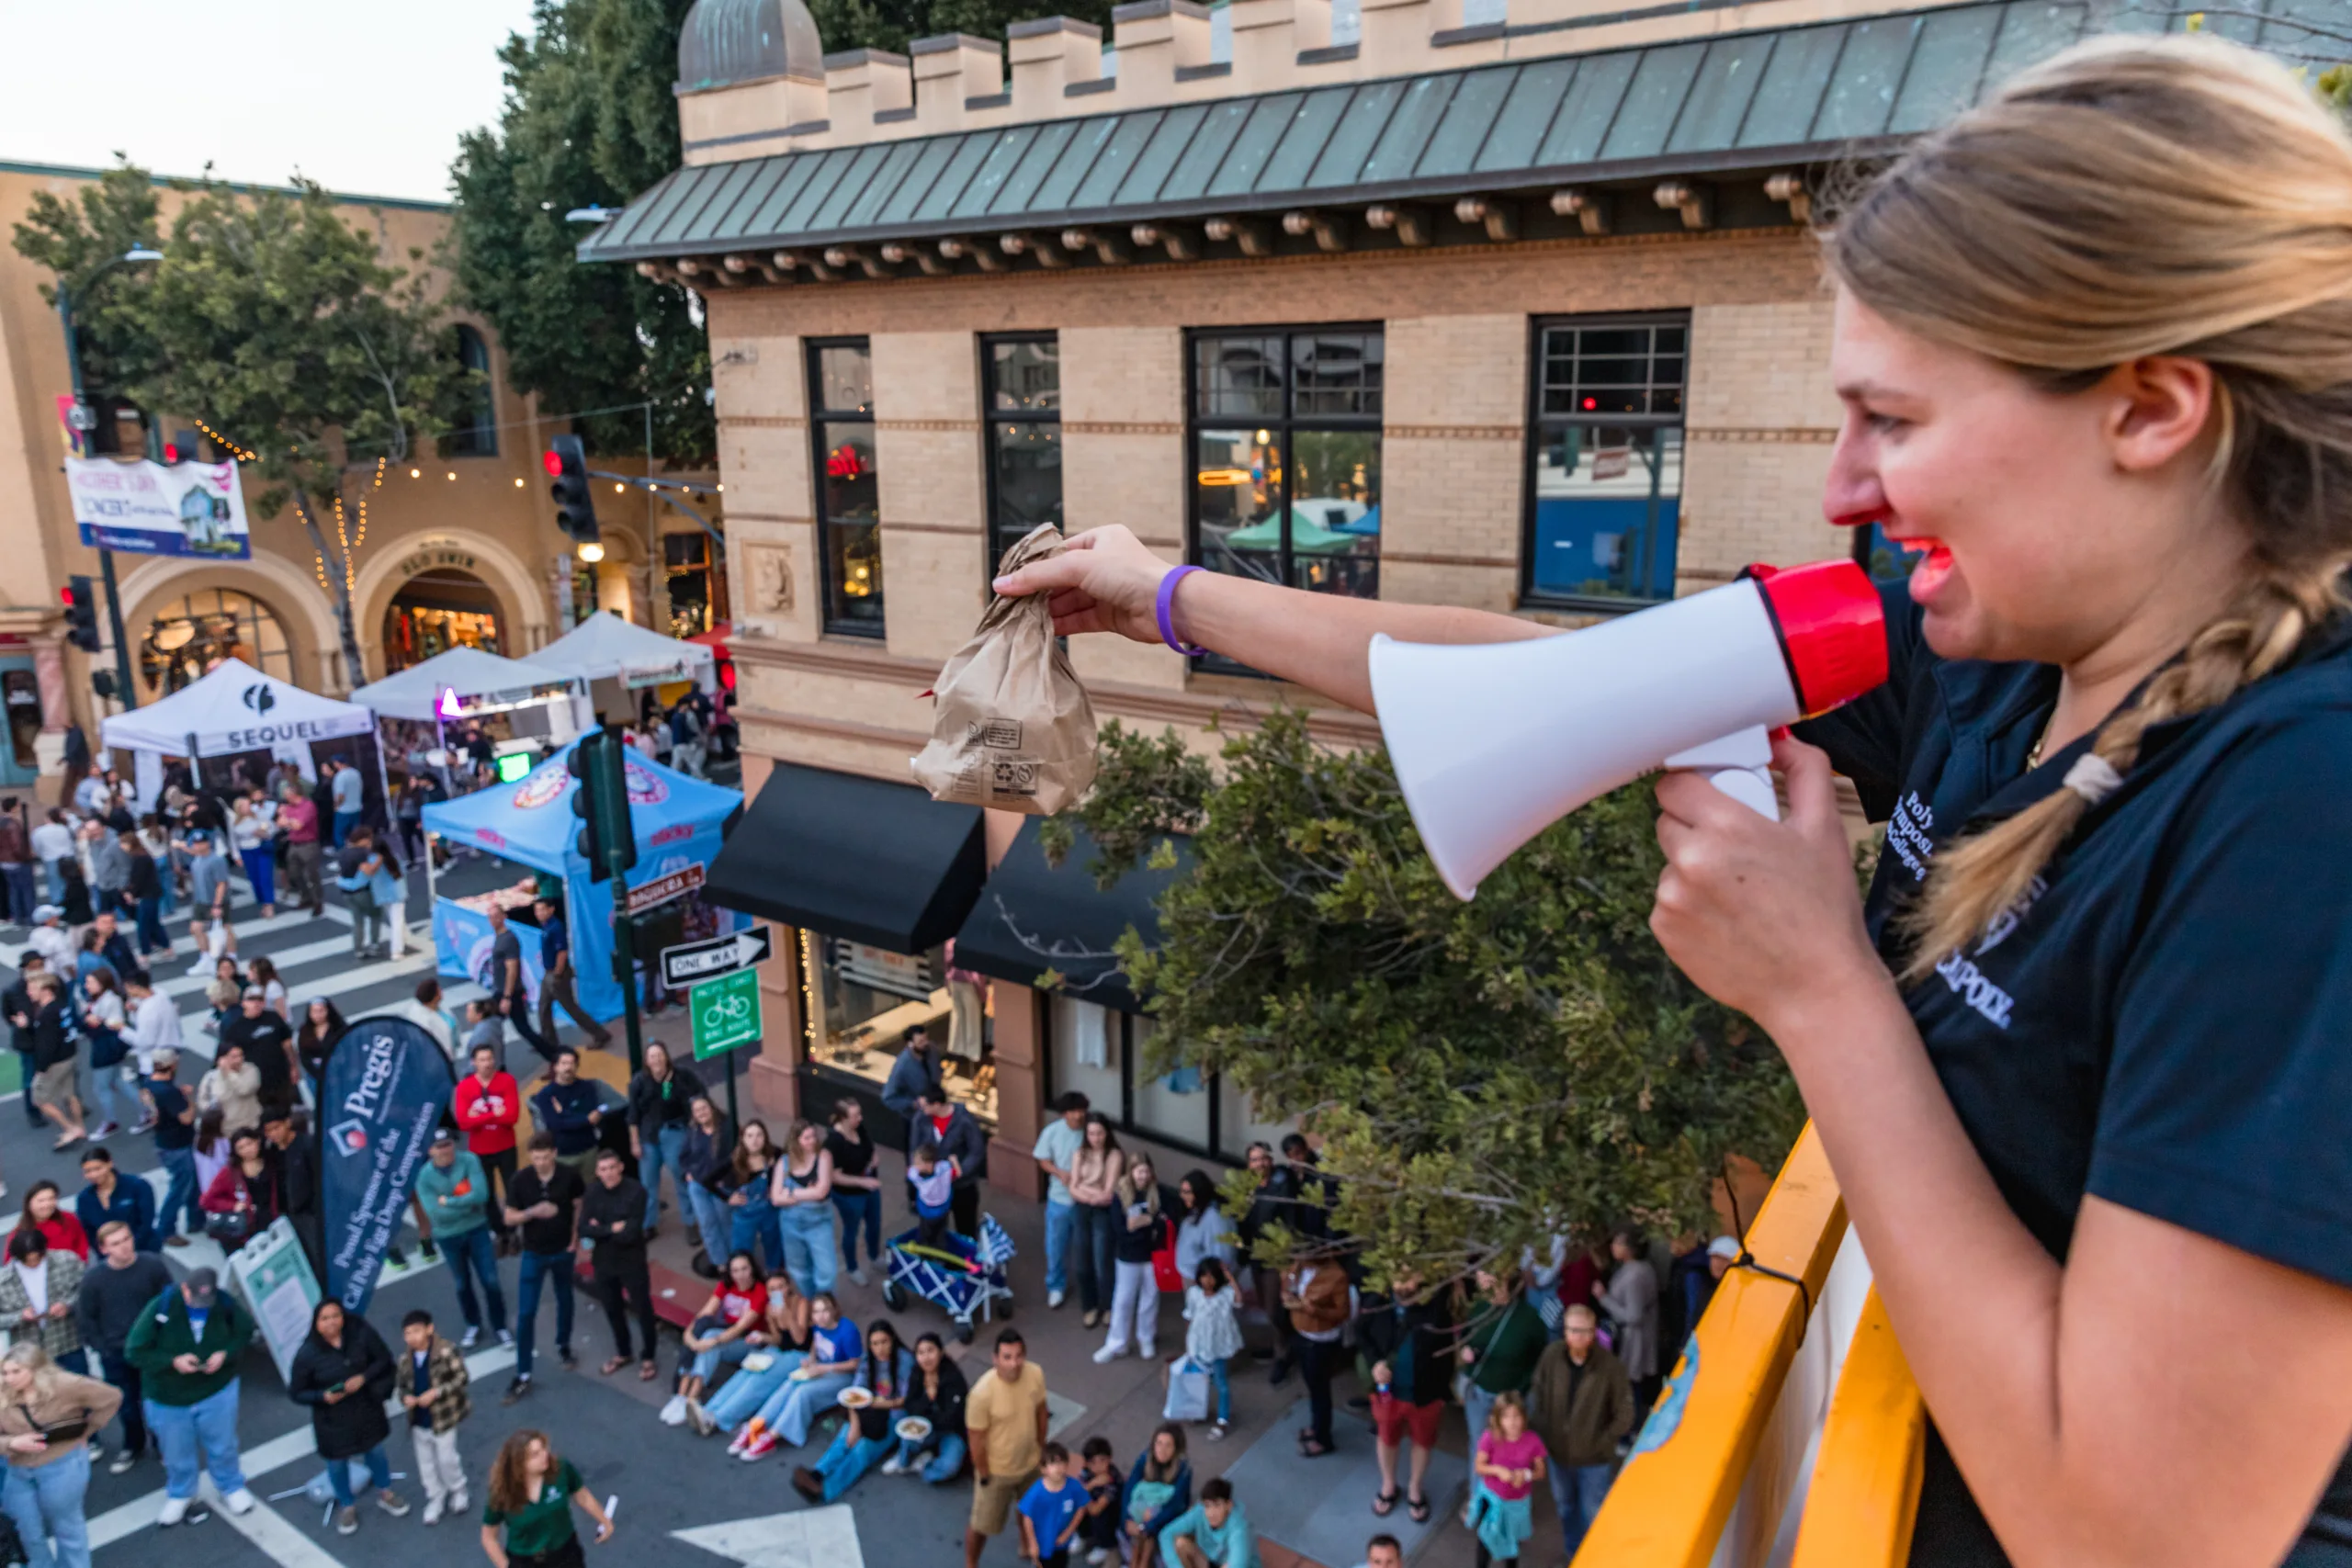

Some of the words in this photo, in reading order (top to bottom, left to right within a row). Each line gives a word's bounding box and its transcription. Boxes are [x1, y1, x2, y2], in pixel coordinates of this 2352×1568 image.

[228, 721, 322, 748] SEQUEL
[1905, 790, 1933, 829] Poly
[675, 957, 699, 972] ONE
[344, 1034, 394, 1120] Pregis
[379, 1127, 401, 1153] the
[390, 1101, 435, 1187] Competition
[375, 1148, 390, 1169] of
[350, 1168, 384, 1226] Sponsor
[374, 1188, 404, 1225] Drop
[334, 1223, 364, 1269] Proud
[364, 1226, 390, 1254] Egg
[351, 1253, 379, 1285] Poly
[342, 1282, 364, 1310] Cal
